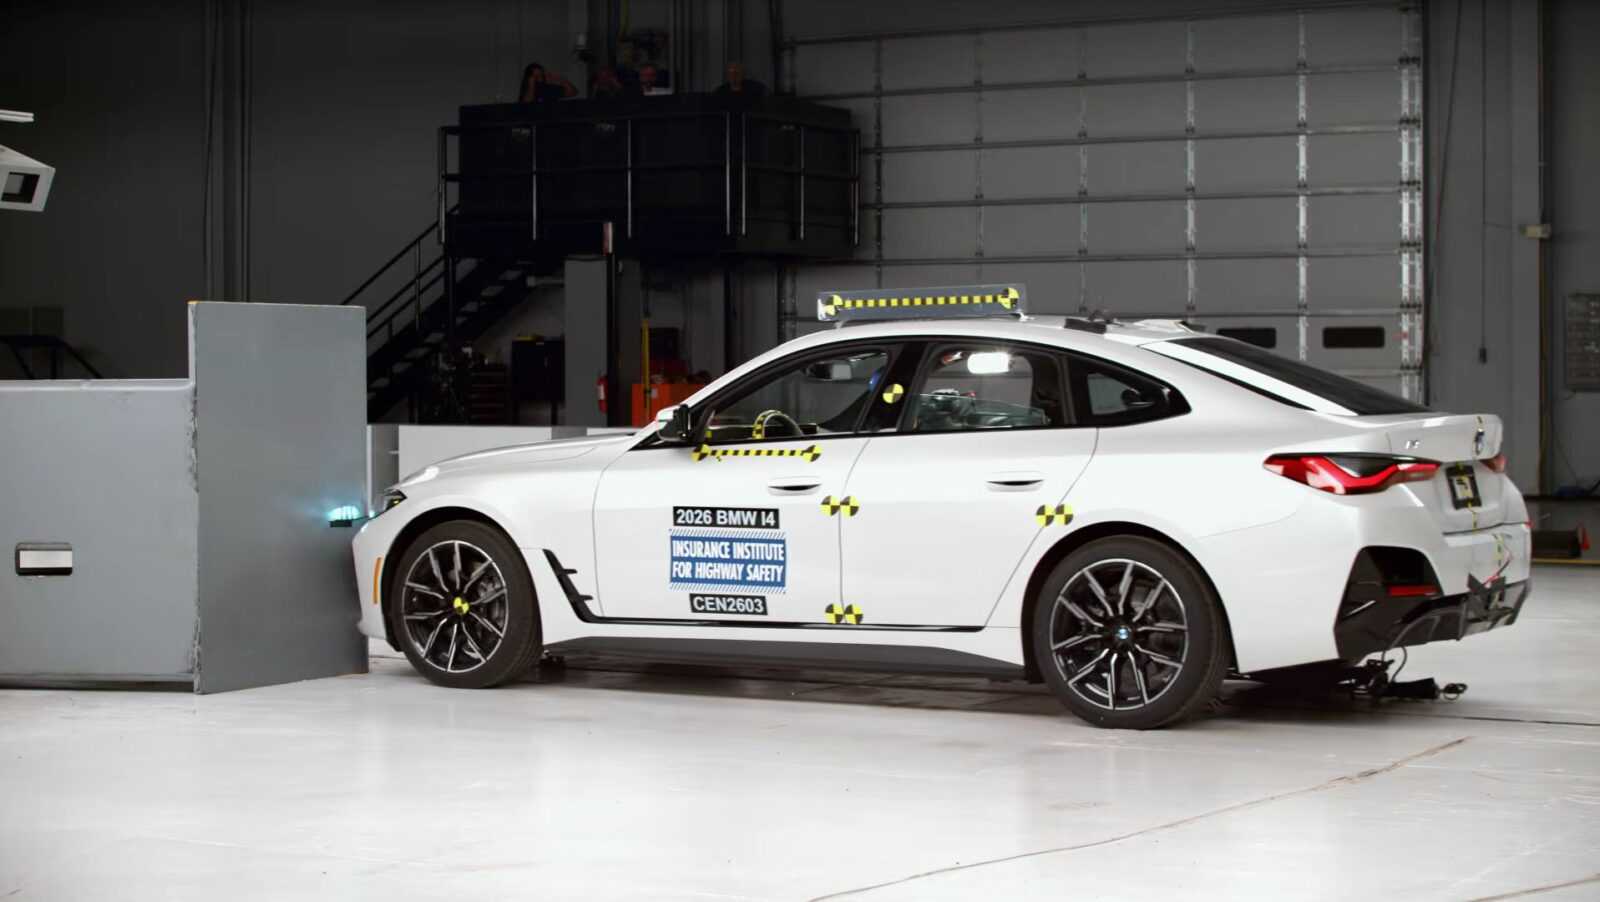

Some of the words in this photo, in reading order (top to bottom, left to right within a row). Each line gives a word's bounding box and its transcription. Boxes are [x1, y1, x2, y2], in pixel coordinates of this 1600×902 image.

[676, 509, 712, 525] 2026
[716, 510, 757, 526] BMW
[672, 540, 730, 559] INSURANCE
[732, 542, 784, 561] INSTITUTE
[672, 561, 692, 578] FOR
[695, 562, 744, 581] HIGHWAY
[746, 564, 783, 582] SAFETY
[693, 596, 764, 613] CEN2603
